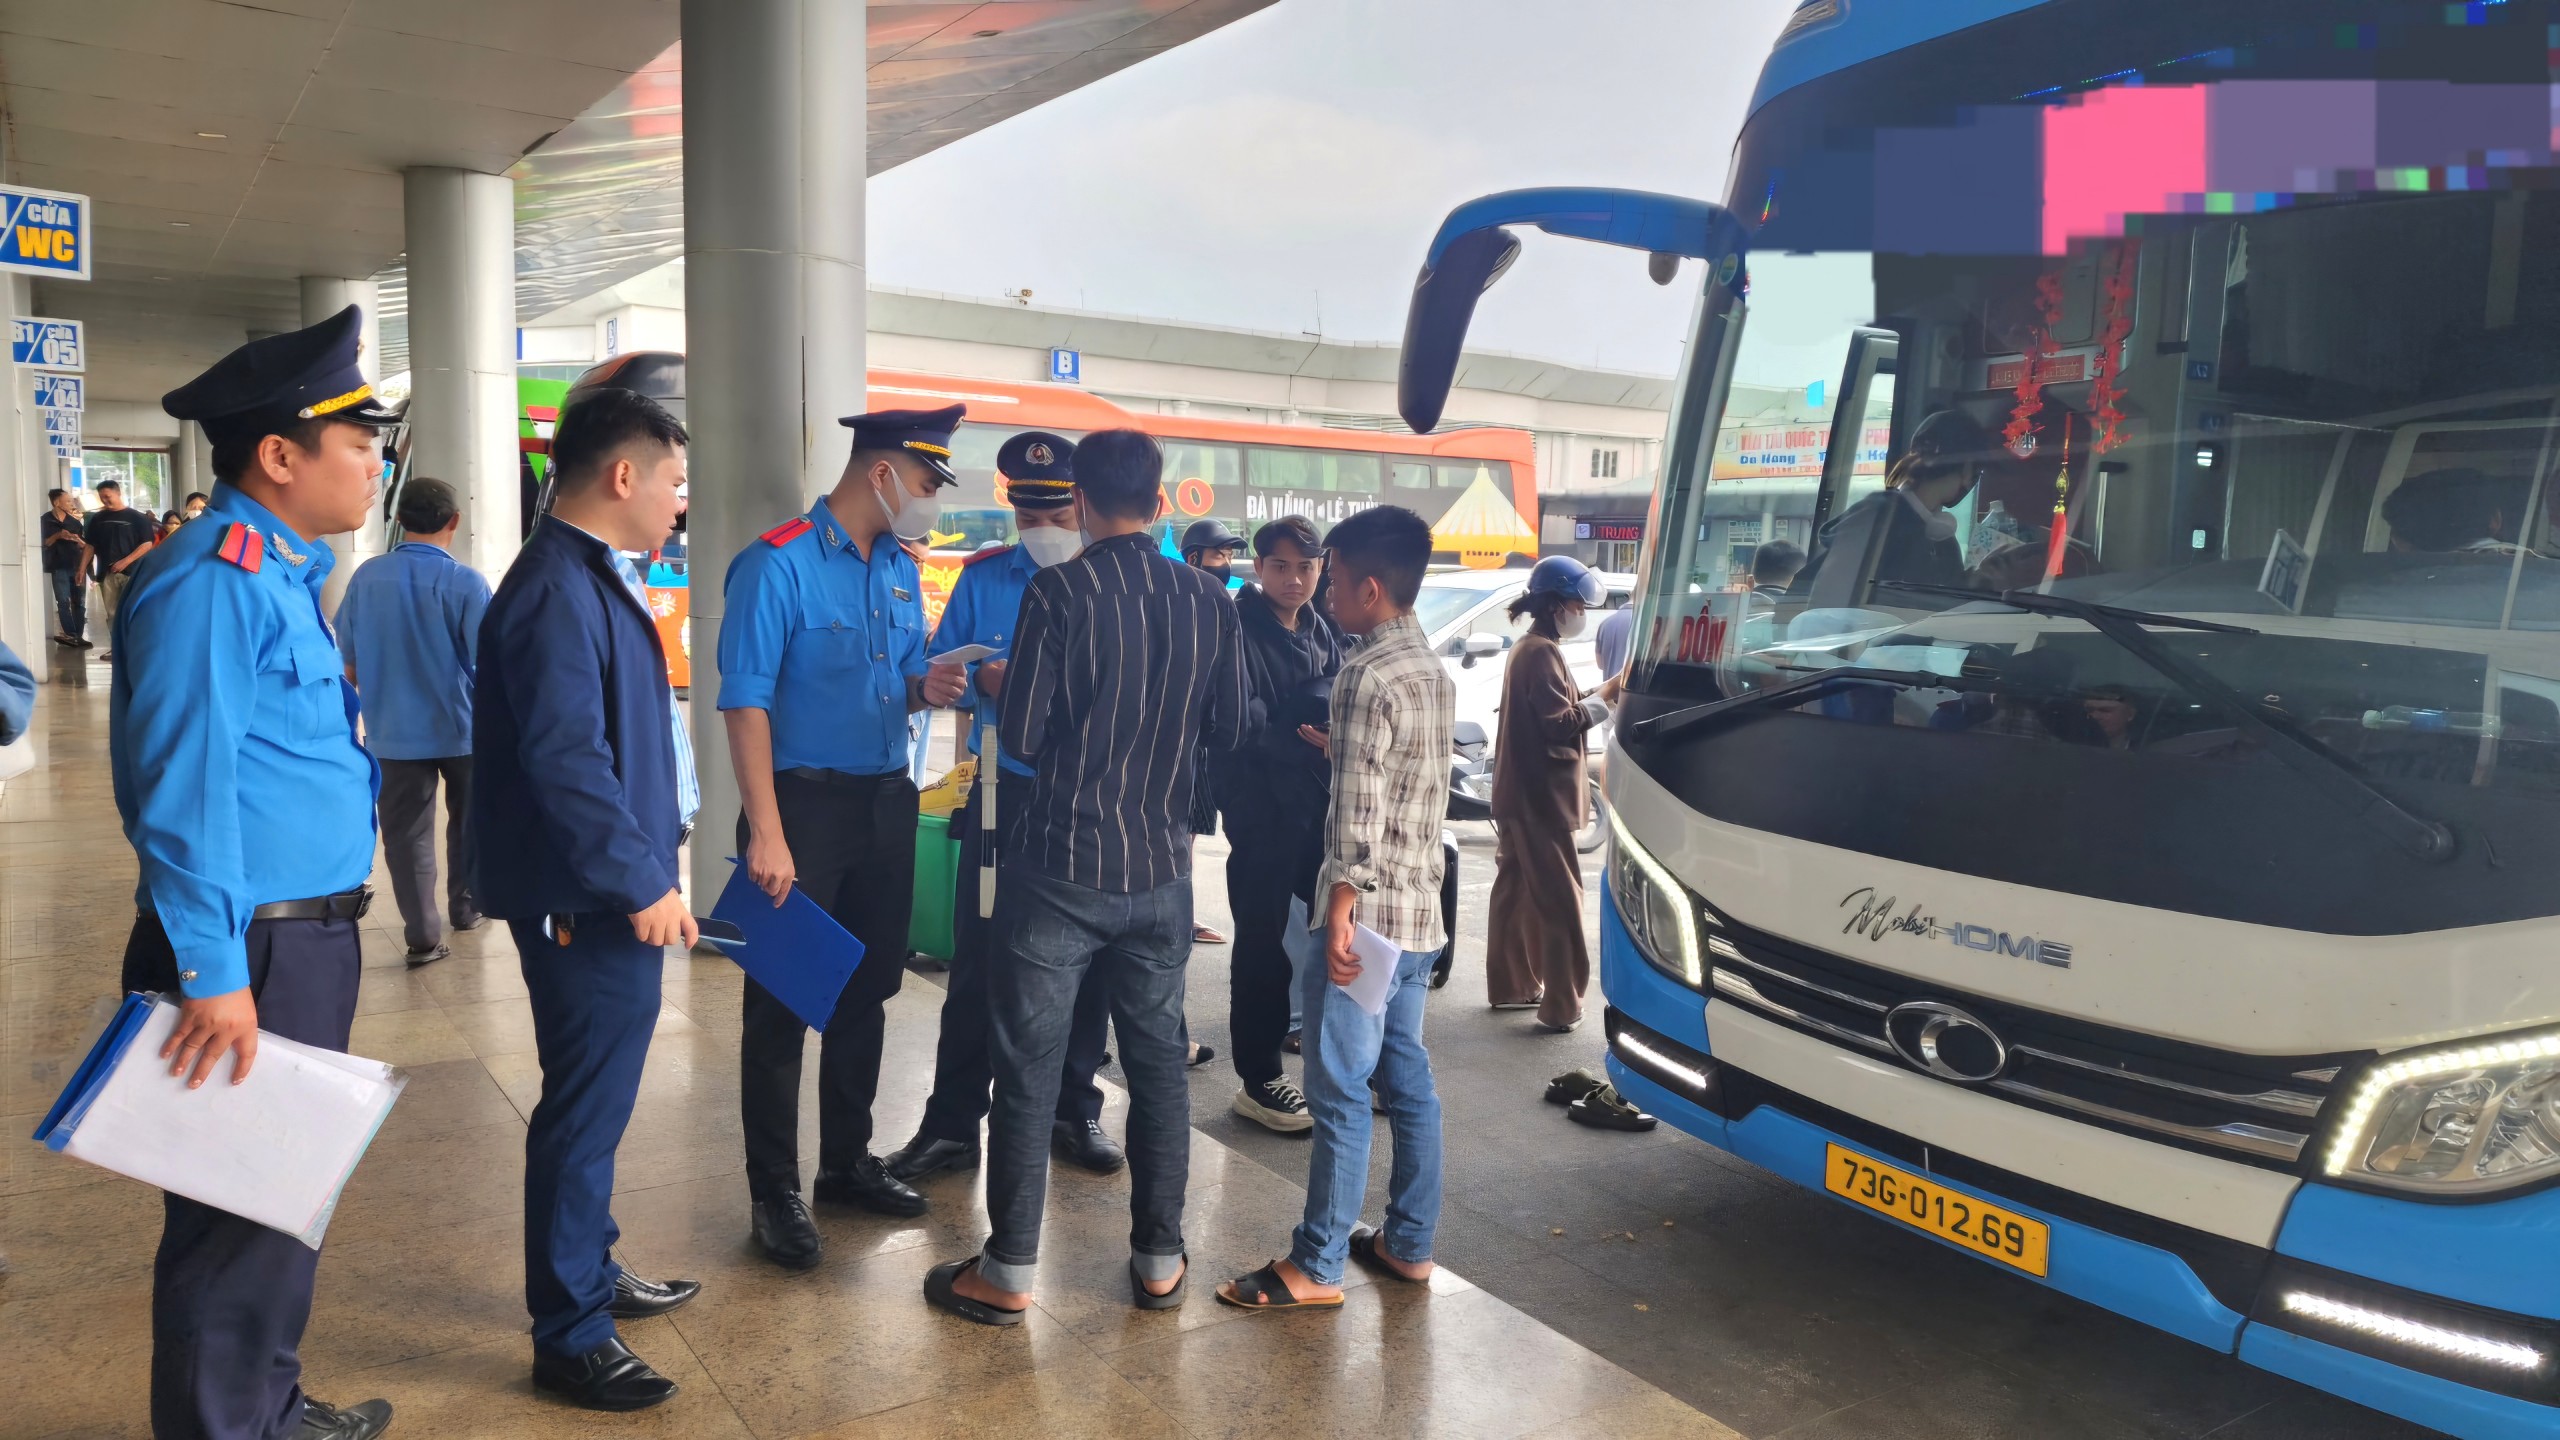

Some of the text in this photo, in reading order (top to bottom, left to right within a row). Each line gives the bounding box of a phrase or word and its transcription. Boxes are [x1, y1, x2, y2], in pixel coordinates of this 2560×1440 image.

[16, 225, 75, 262] WC
[42, 338, 78, 365] 05
[1058, 350, 1073, 374] B
[53, 388, 79, 407] 04
[1843, 1157, 2025, 1258] 73G-012.69
